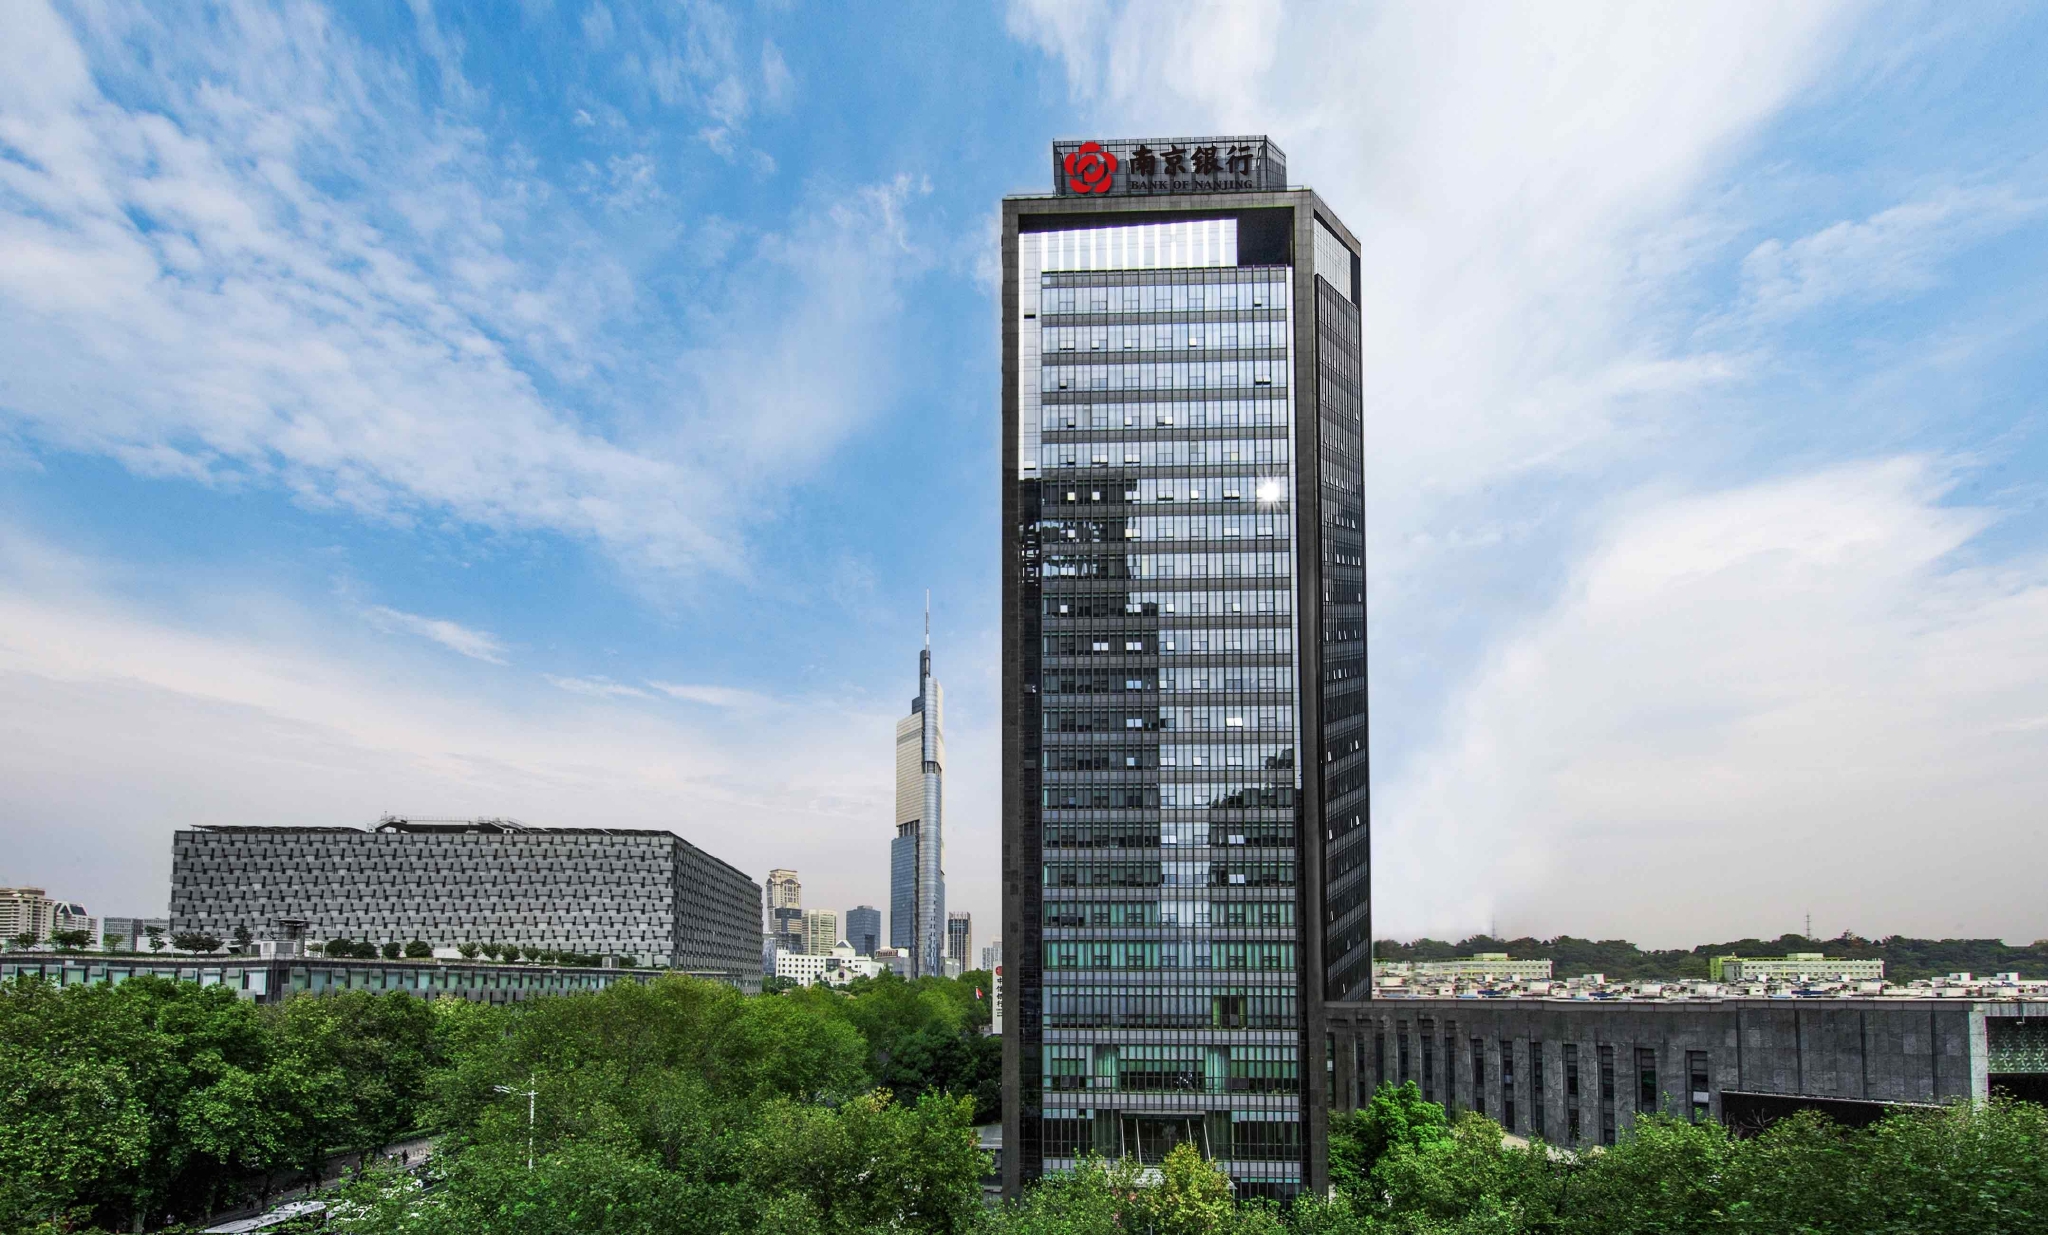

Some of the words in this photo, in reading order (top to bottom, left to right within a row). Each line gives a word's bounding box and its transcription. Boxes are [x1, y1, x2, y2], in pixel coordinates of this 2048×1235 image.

[1131, 180, 1168, 190] BANK
[1173, 180, 1190, 190] OF
[1195, 180, 1253, 191] NANJING
